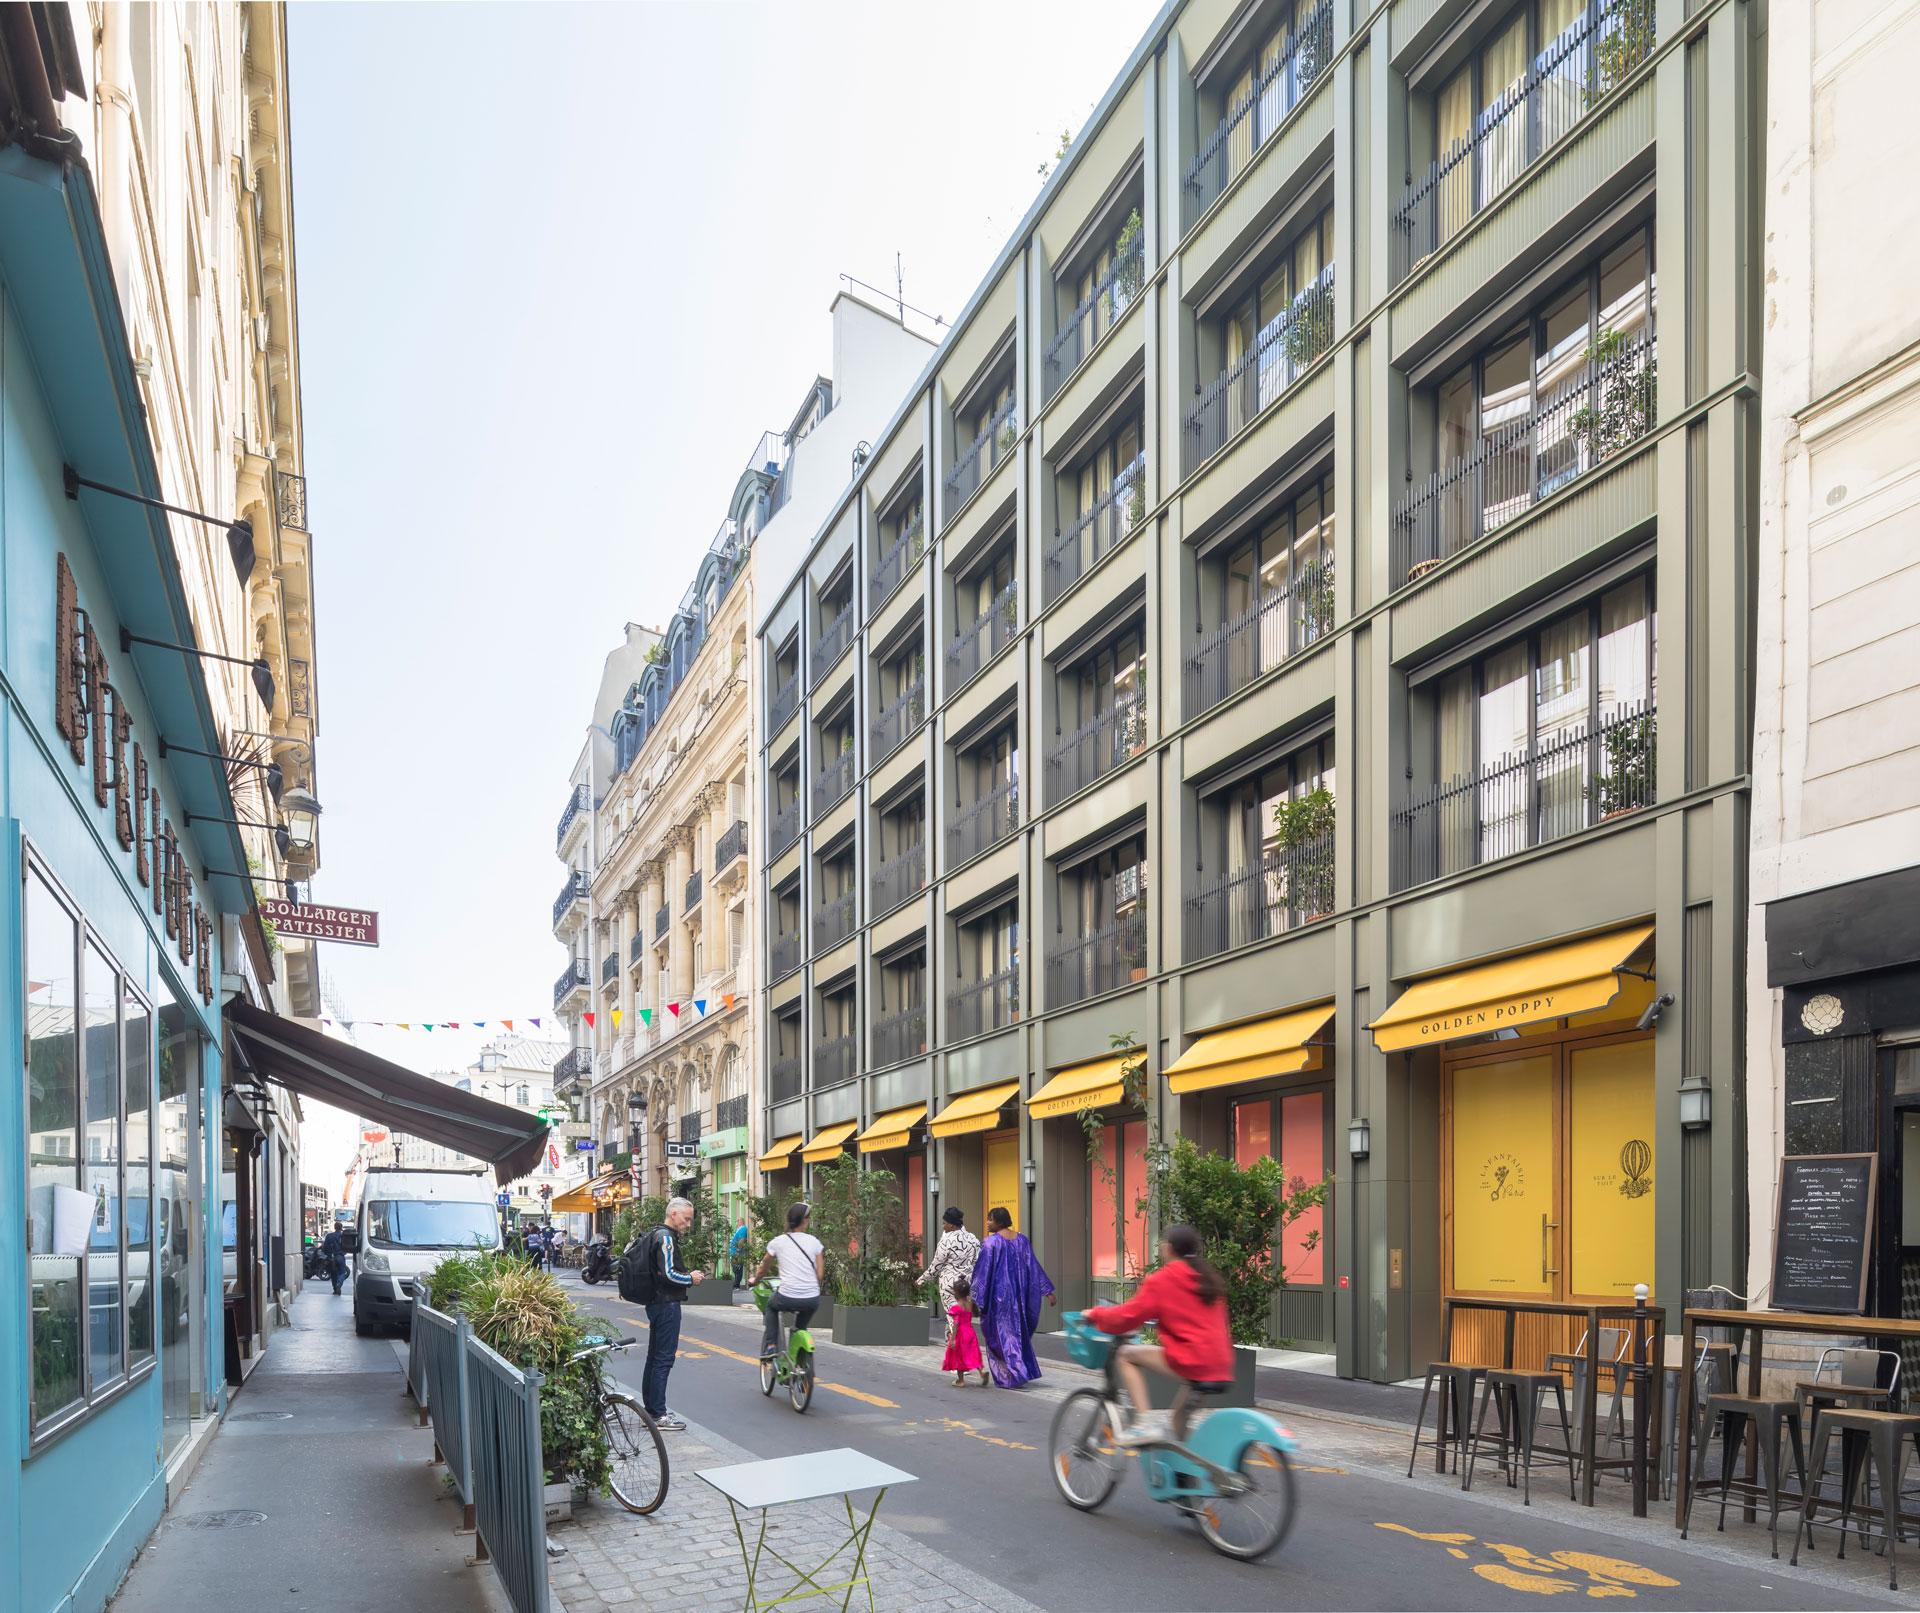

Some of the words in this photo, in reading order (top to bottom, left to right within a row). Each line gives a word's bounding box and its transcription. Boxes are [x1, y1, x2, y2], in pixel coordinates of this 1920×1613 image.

[266, 900, 372, 926] BOULANGER
[271, 917, 366, 940] PATISSIER
[1421, 1011, 1486, 1035] GOLDEN
[1496, 996, 1555, 1019] POPPY
[1047, 1099, 1075, 1111] GOLDEN
[1078, 1092, 1103, 1105] POPPY
